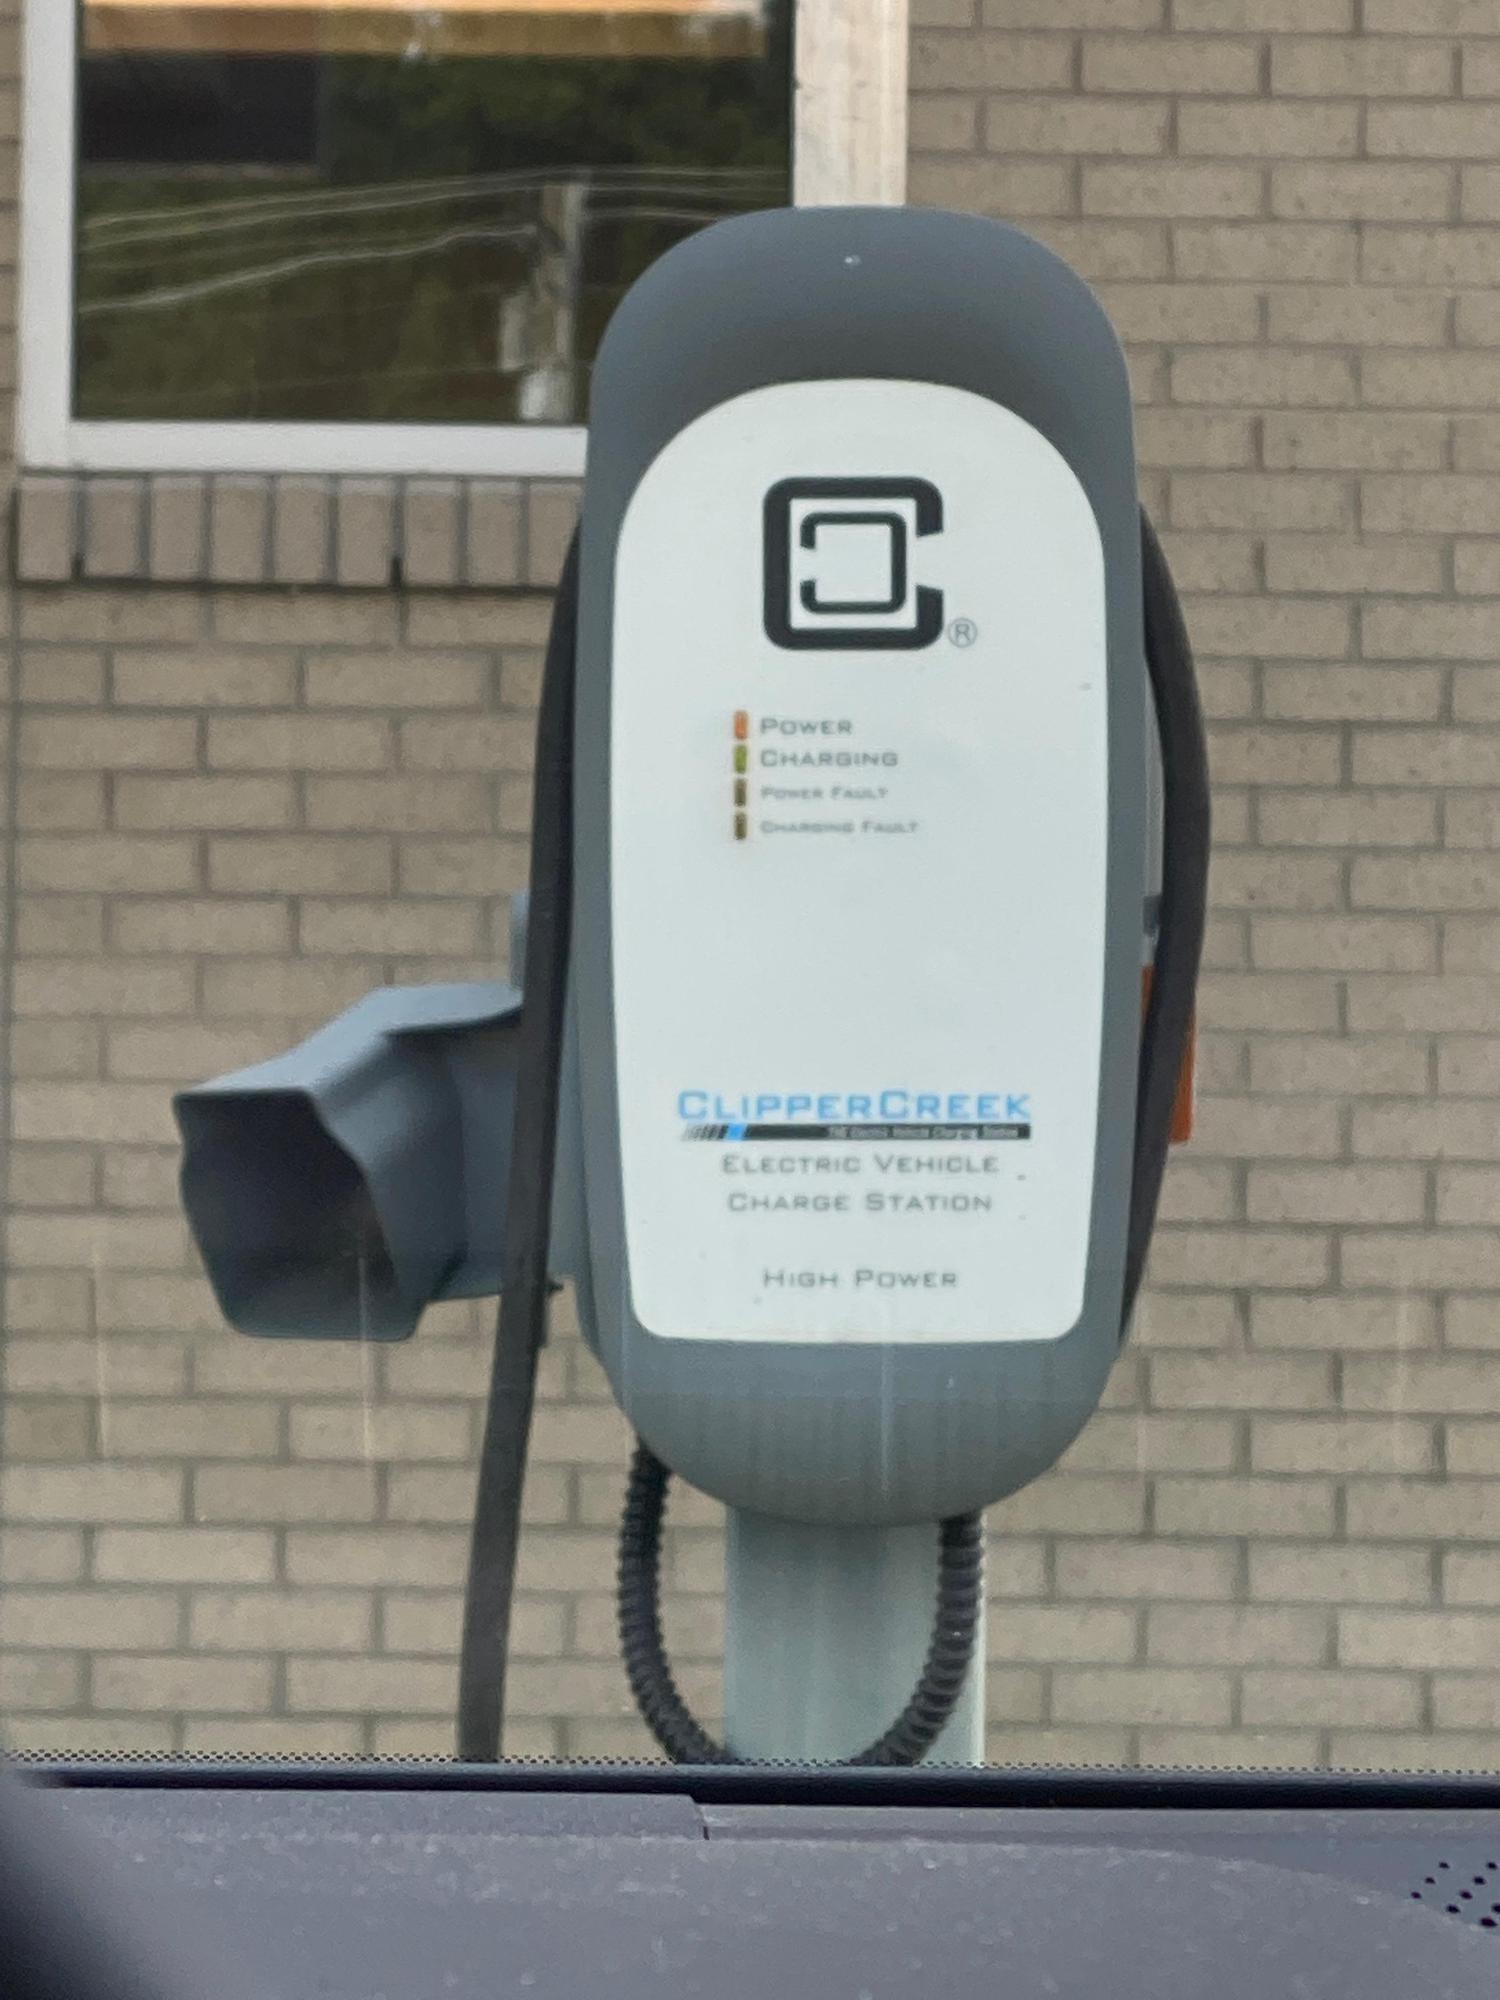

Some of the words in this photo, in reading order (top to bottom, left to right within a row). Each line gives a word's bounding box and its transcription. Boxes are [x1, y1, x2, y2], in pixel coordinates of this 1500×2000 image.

[760, 717, 853, 735] POWER
[760, 749, 899, 767] CHARGING
[760, 786, 824, 800] POWER
[830, 786, 889, 800] FAULT
[760, 820, 855, 834] CHARGING
[721, 1154, 862, 1174] ELECTRIC
[873, 1154, 1000, 1174] VEHICLE
[726, 1192, 850, 1212] CHARGE
[864, 1192, 993, 1212] STATION
[762, 1270, 839, 1288] HIGH
[854, 1269, 958, 1288] POWER
